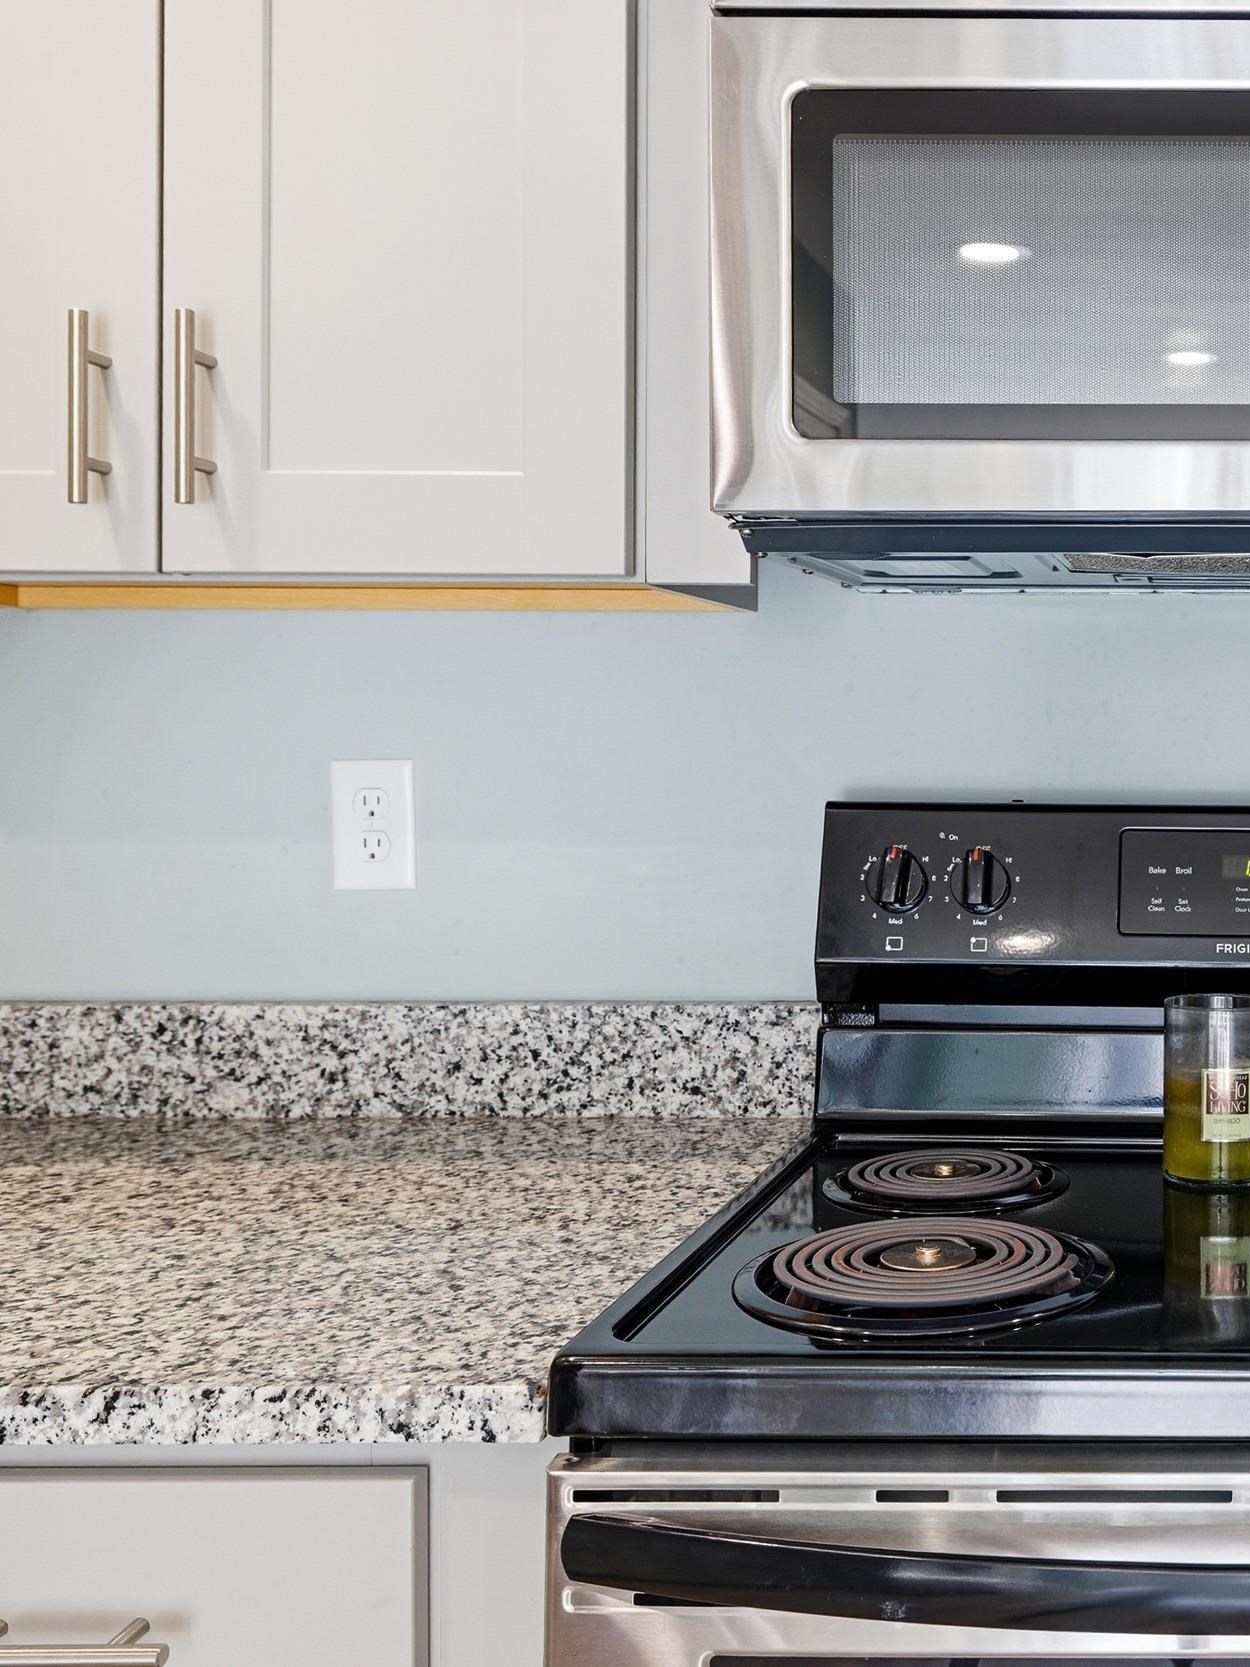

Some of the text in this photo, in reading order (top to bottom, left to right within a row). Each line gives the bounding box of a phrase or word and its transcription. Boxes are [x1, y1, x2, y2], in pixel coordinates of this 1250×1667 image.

[1148, 867, 1167, 875] Bake
[1175, 867, 1192, 875] Broil
[1210, 1101, 1246, 1112] LIVING
